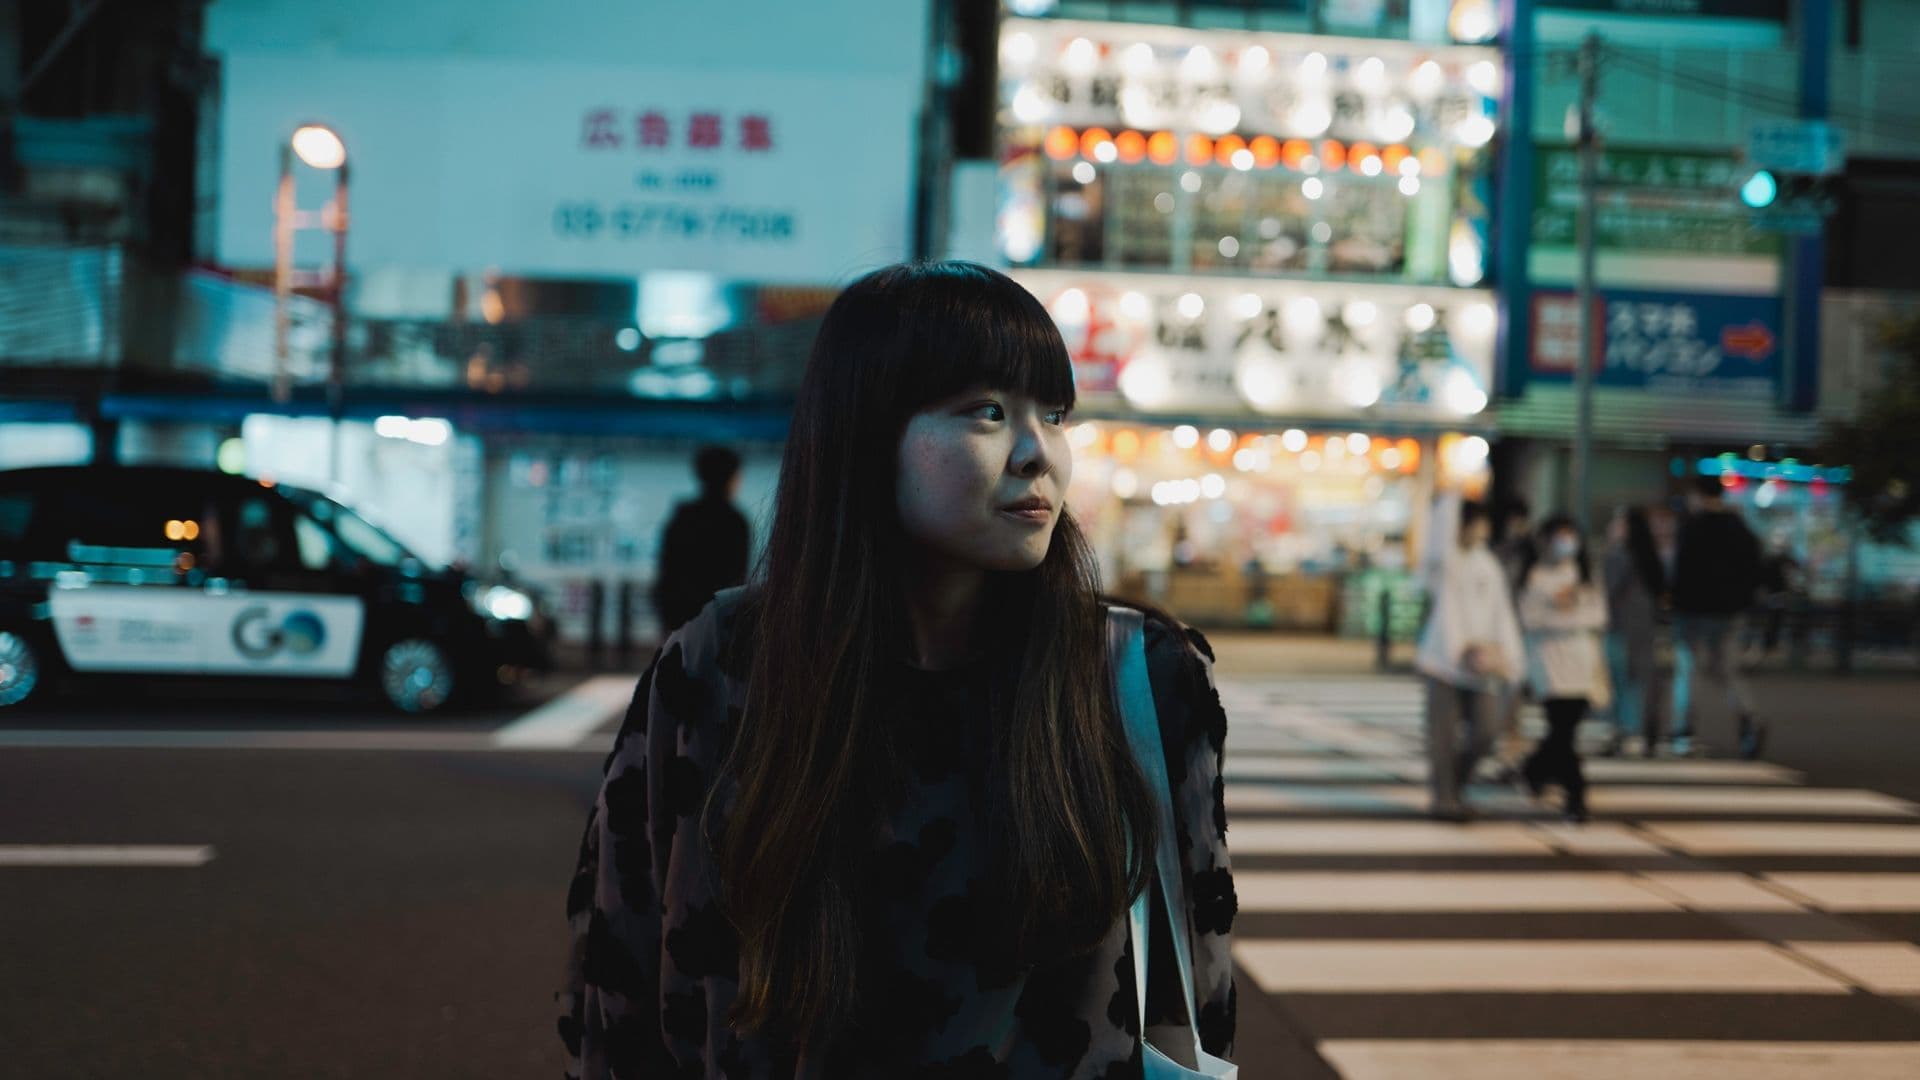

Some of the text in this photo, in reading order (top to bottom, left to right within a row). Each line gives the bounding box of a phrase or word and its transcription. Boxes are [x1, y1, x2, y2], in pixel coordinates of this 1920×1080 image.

[581, 108, 777, 151] 広告募集
[1607, 301, 1697, 337] スマホ
[1606, 334, 1723, 376] パソコン
